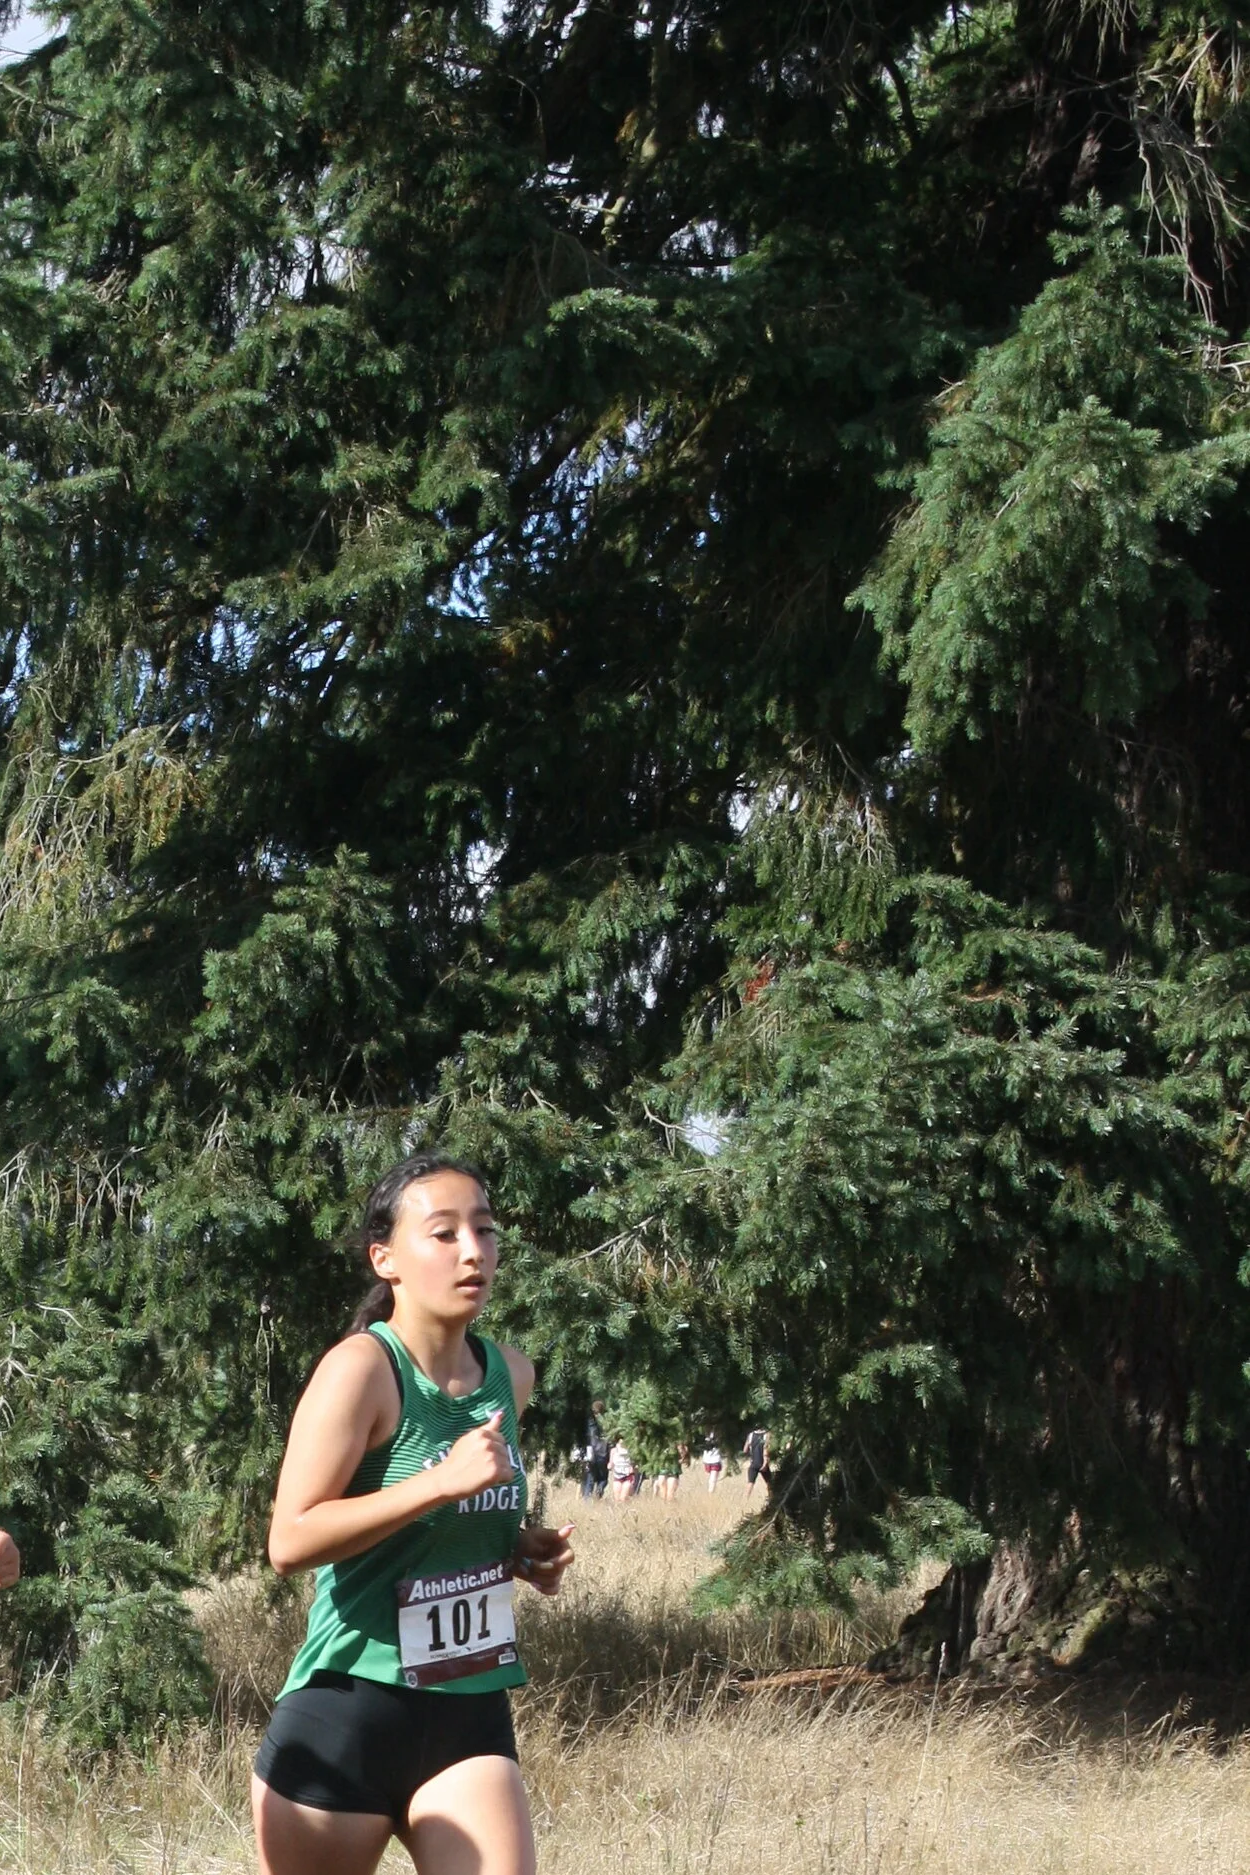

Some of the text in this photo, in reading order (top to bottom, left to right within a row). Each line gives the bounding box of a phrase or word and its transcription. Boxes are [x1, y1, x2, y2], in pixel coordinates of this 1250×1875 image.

[457, 1485, 520, 1514] RIDGE
[407, 1563, 504, 1602] Athletic.net
[426, 1594, 491, 1652] 101
